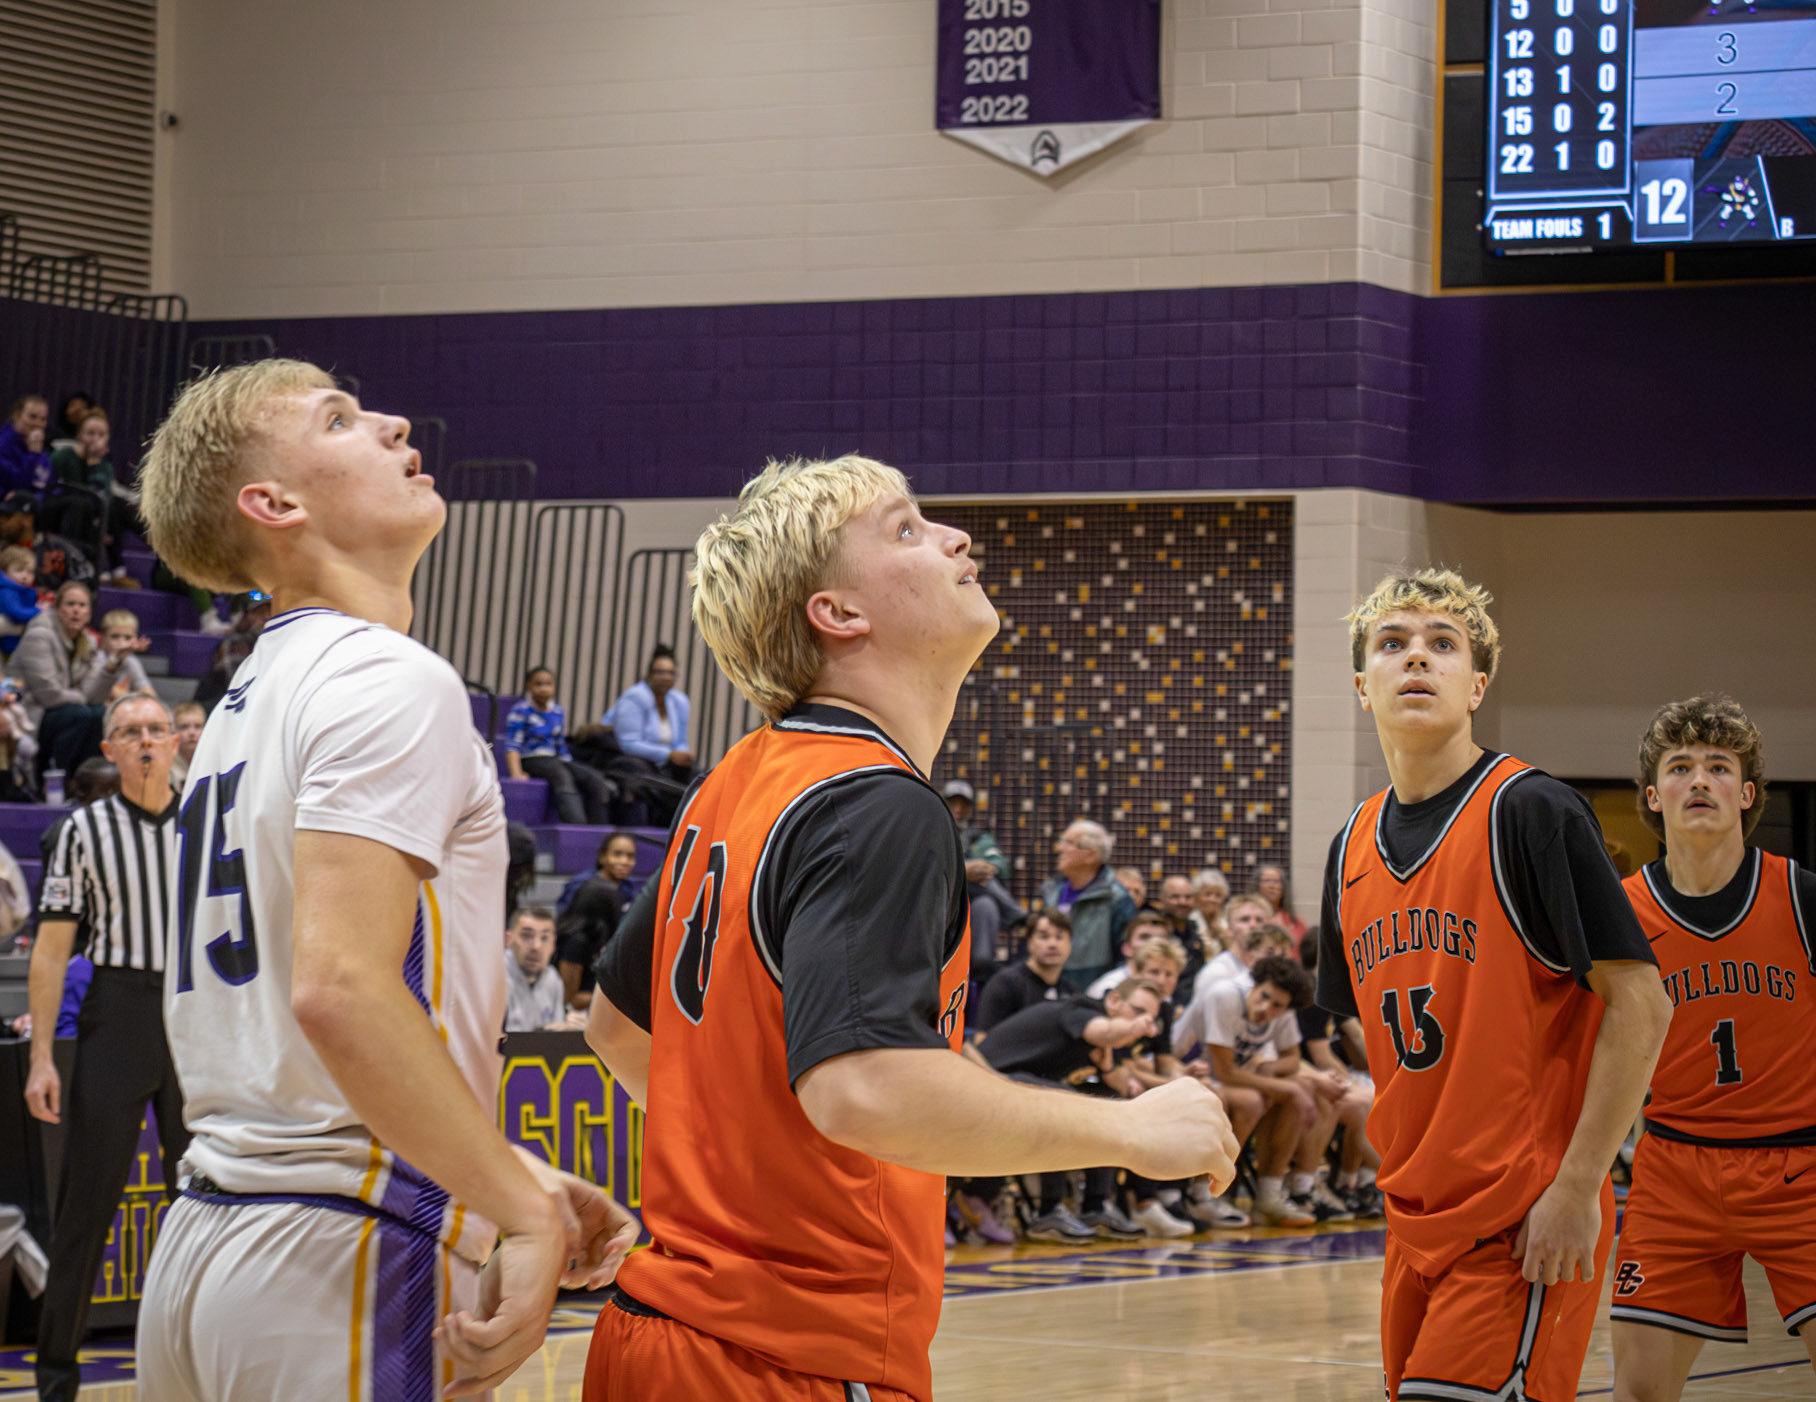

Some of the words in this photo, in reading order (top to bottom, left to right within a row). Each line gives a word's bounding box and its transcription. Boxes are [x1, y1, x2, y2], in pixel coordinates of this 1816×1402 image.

[964, 0, 1030, 20] 2015
[1510, 0, 1529, 20] 5
[963, 26, 1032, 55] 2020
[1503, 28, 1535, 59] 12
[1554, 26, 1574, 56] 0
[1598, 23, 1617, 54] 0
[1717, 31, 1738, 66] 3
[964, 54, 1029, 85] 2021
[1502, 66, 1534, 97] 13
[1555, 64, 1571, 94] 1
[1597, 62, 1617, 92] 0
[960, 94, 1029, 123] 2022
[1716, 82, 1739, 115] 2
[1502, 105, 1534, 136] 15
[1553, 102, 1573, 133] 0
[1597, 101, 1616, 131] 2
[1500, 143, 1534, 174] 22
[1553, 141, 1569, 171] 1
[1596, 139, 1615, 170] 0
[1640, 178, 1687, 225] 12
[1492, 219, 1534, 240] TEAM
[1535, 216, 1583, 239] FOULS
[1597, 211, 1612, 240] 1
[1780, 216, 1795, 238] B
[177, 760, 259, 994] 15
[1351, 906, 1478, 989] BULLDOGS
[1662, 960, 1797, 1008] ULLDOGS
[1710, 1018, 1743, 1086] 1
[1615, 1260, 1646, 1297] BC
